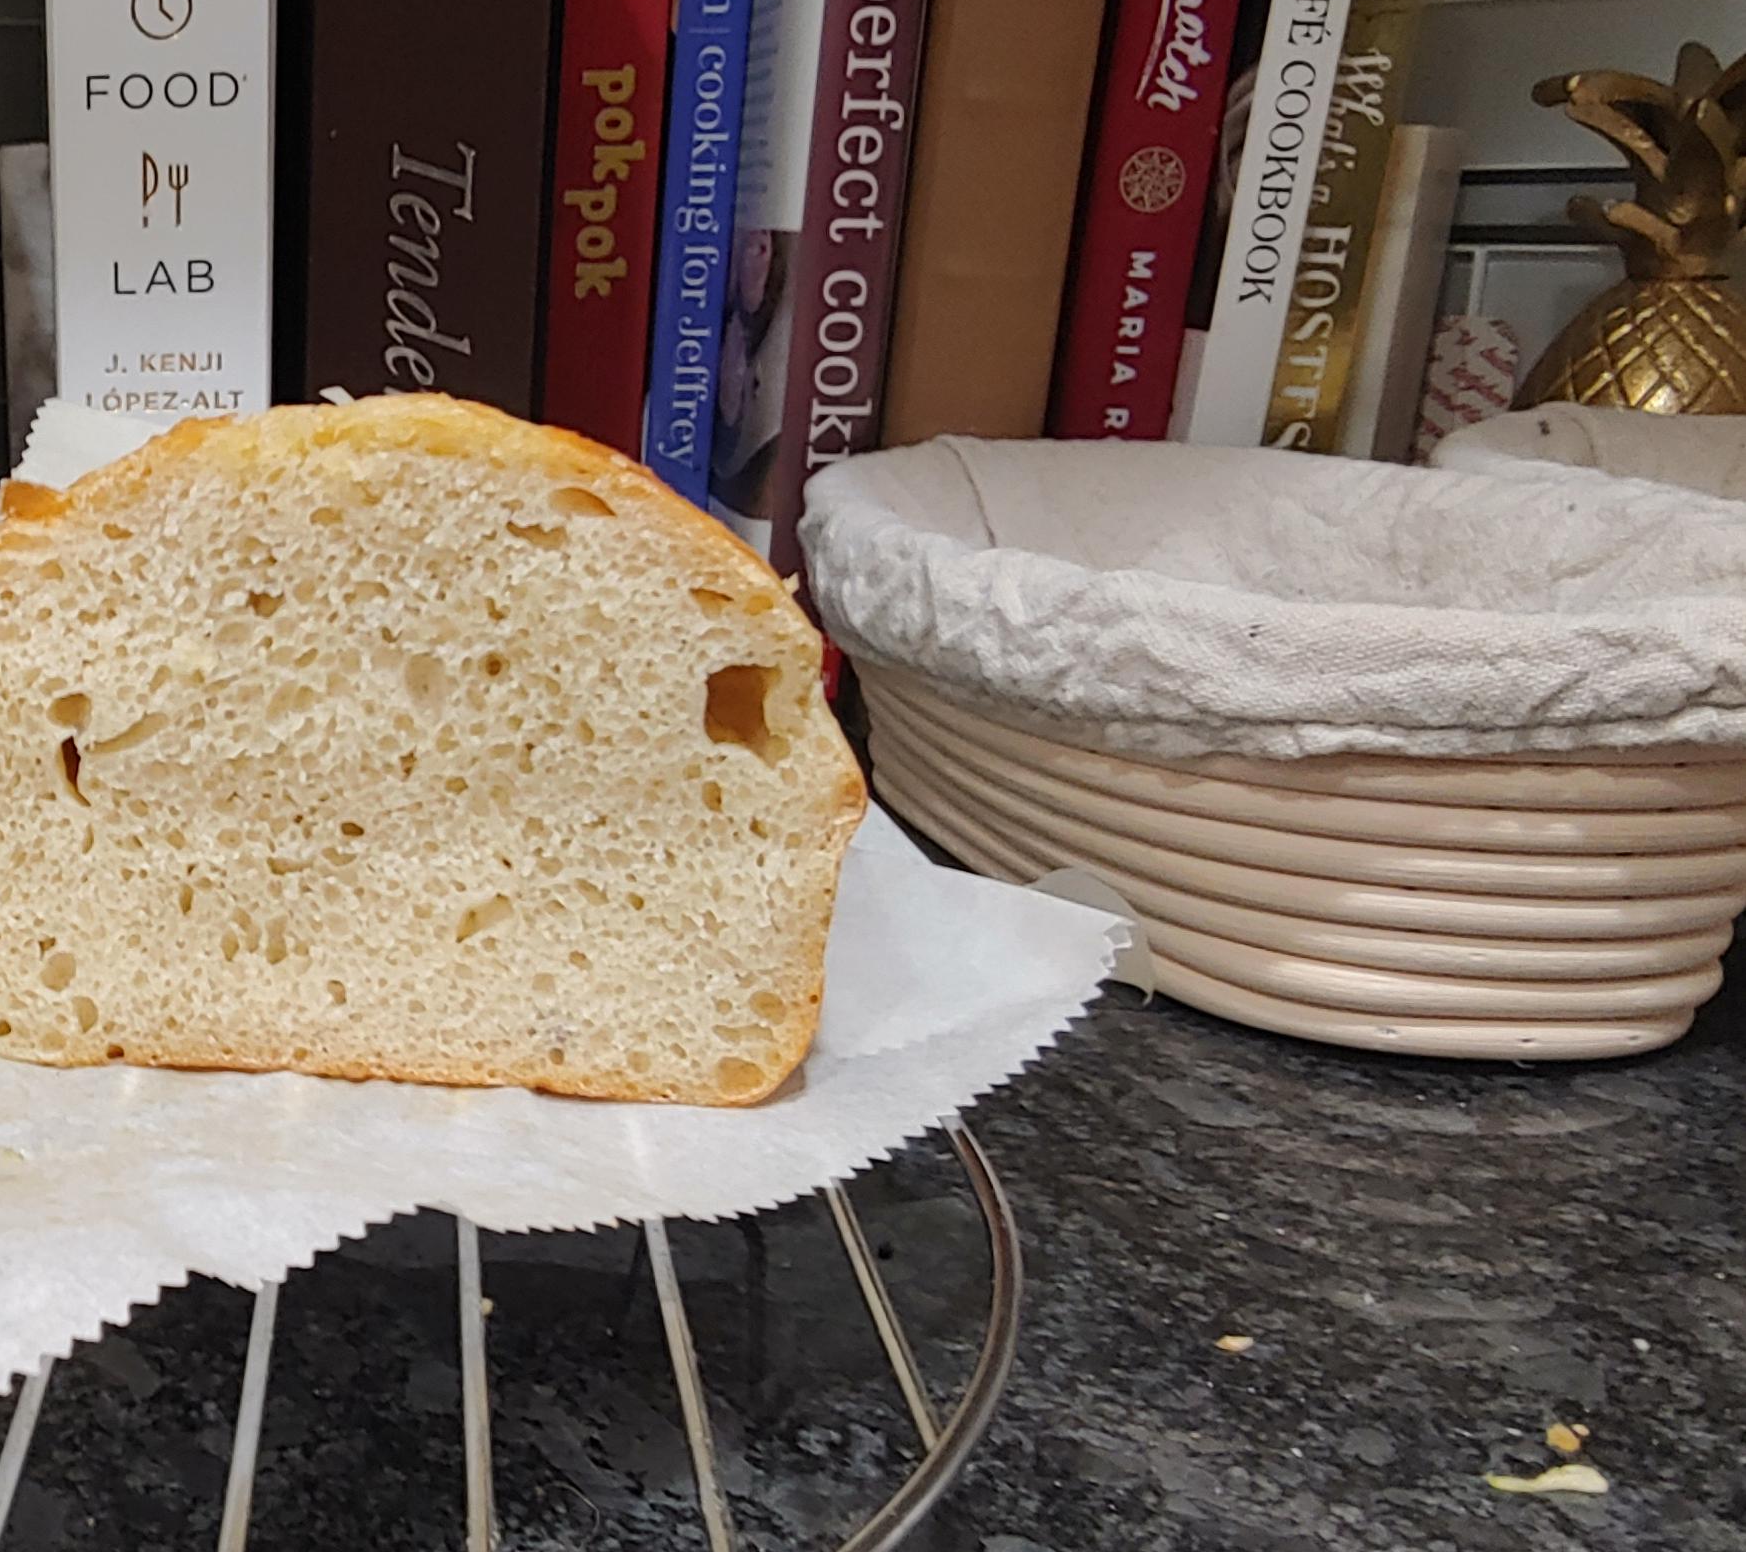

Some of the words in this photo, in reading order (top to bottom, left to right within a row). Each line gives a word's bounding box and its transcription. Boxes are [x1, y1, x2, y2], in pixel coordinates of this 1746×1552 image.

[84, 72, 241, 111] FOOD
[674, 44, 729, 235] cooking
[1238, 58, 1317, 306] COOKBOOK
[114, 260, 215, 296] LAB
[384, 142, 477, 395] Tende
[681, 242, 721, 309] for
[1111, 250, 1156, 385] MARIA
[104, 354, 128, 374] J.
[140, 352, 223, 373] KENJI
[658, 314, 712, 468] Jeffrey
